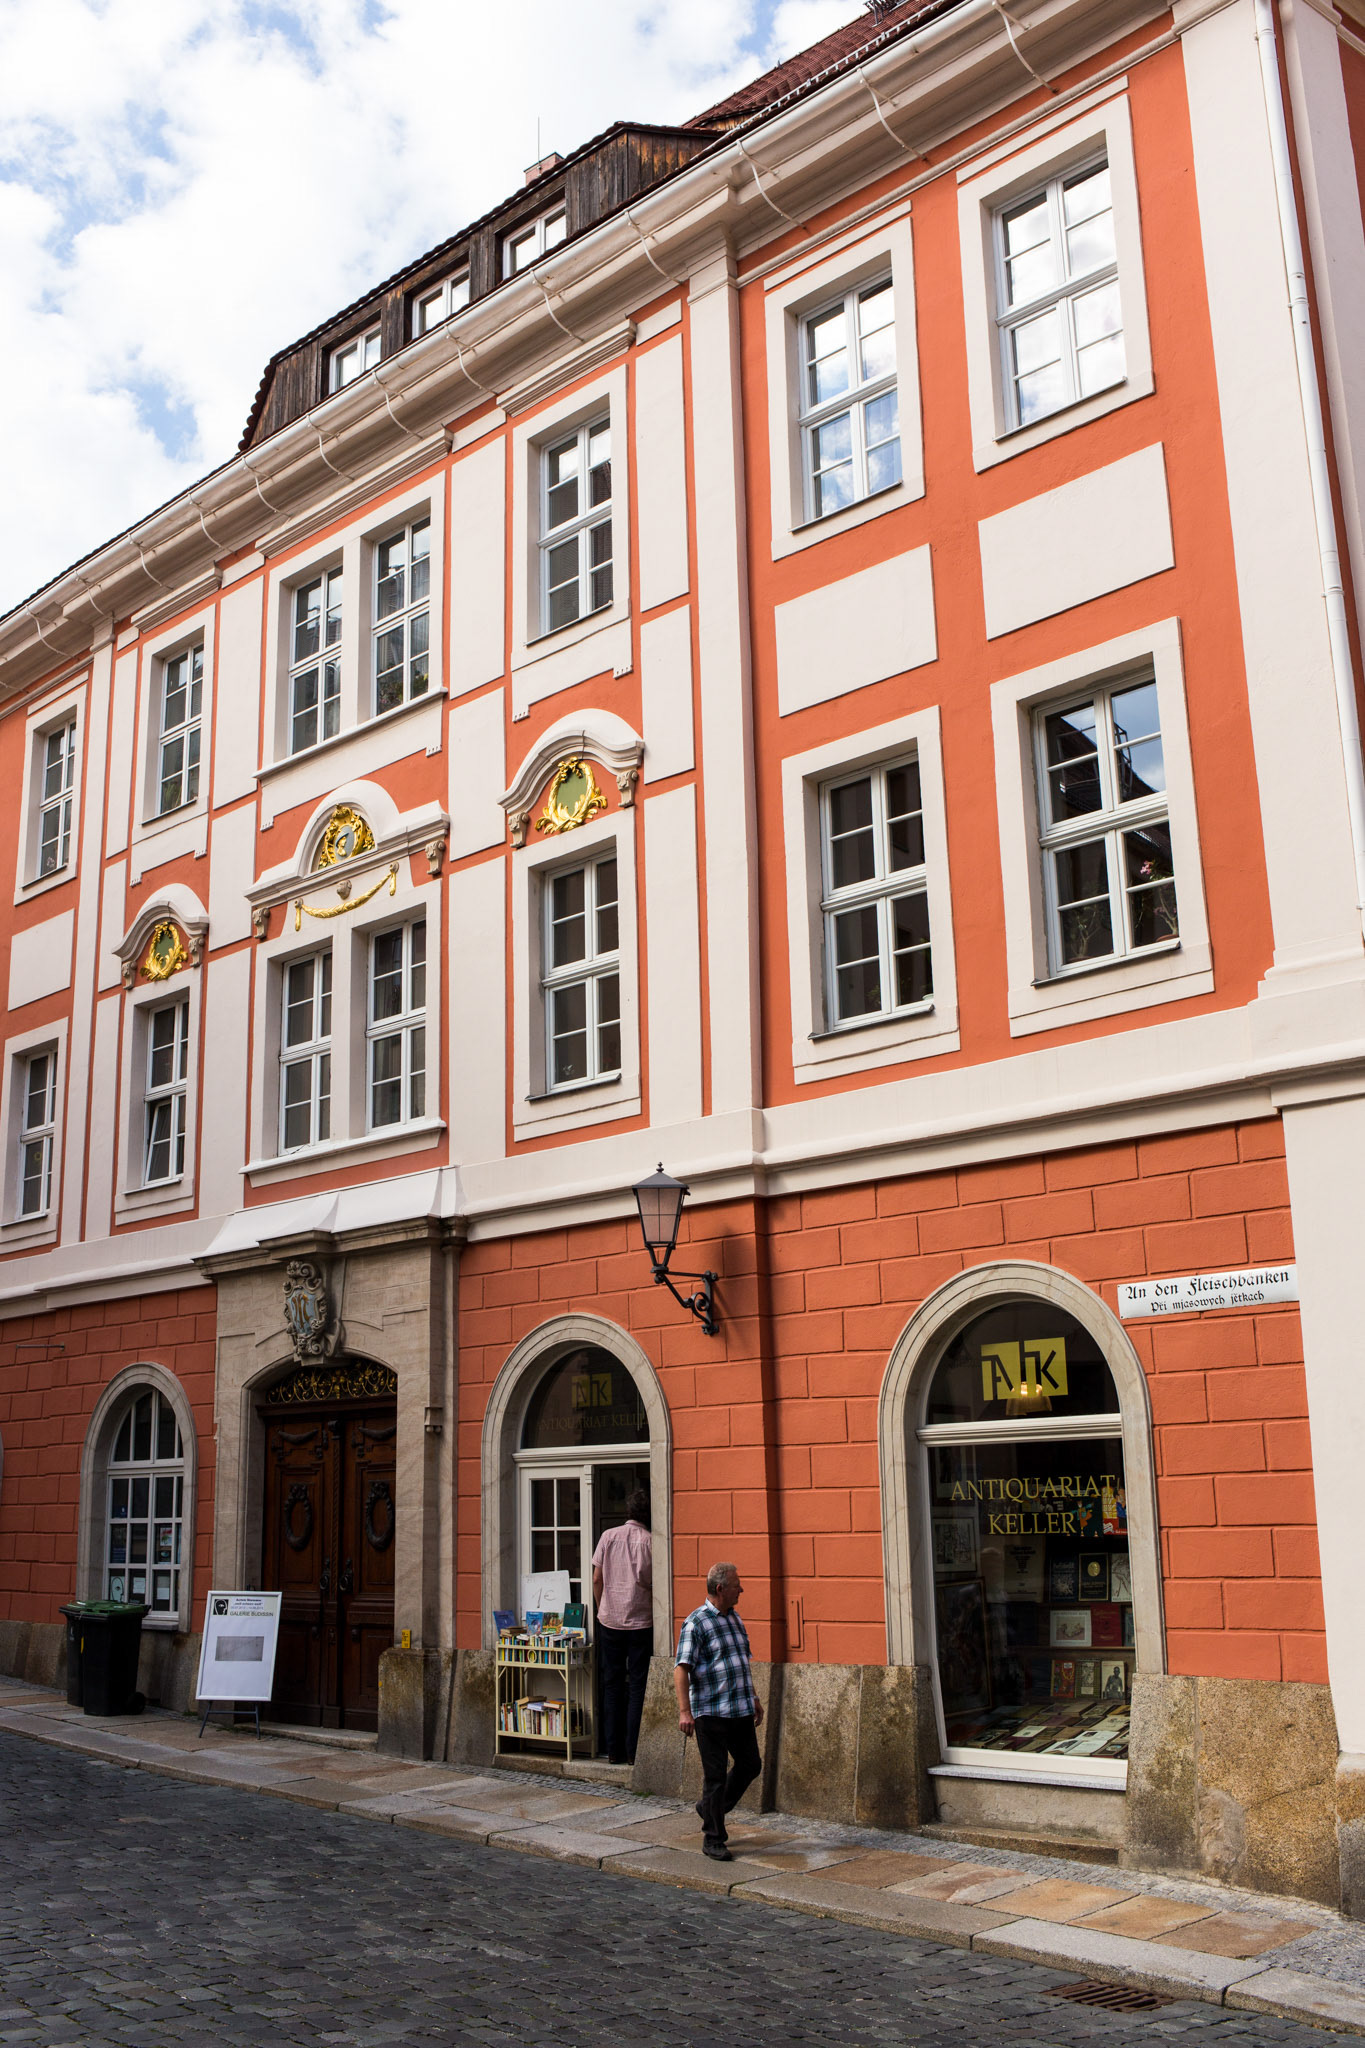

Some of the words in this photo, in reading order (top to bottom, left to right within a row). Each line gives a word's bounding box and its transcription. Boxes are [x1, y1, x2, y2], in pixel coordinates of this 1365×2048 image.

[1125, 1286, 1147, 1300] An
[1155, 1283, 1178, 1297] den
[981, 1345, 1063, 1400] AK
[572, 1379, 610, 1408] AK
[951, 1474, 1116, 1503] ANTIQUARIAT
[988, 1512, 1077, 1535] KELLER
